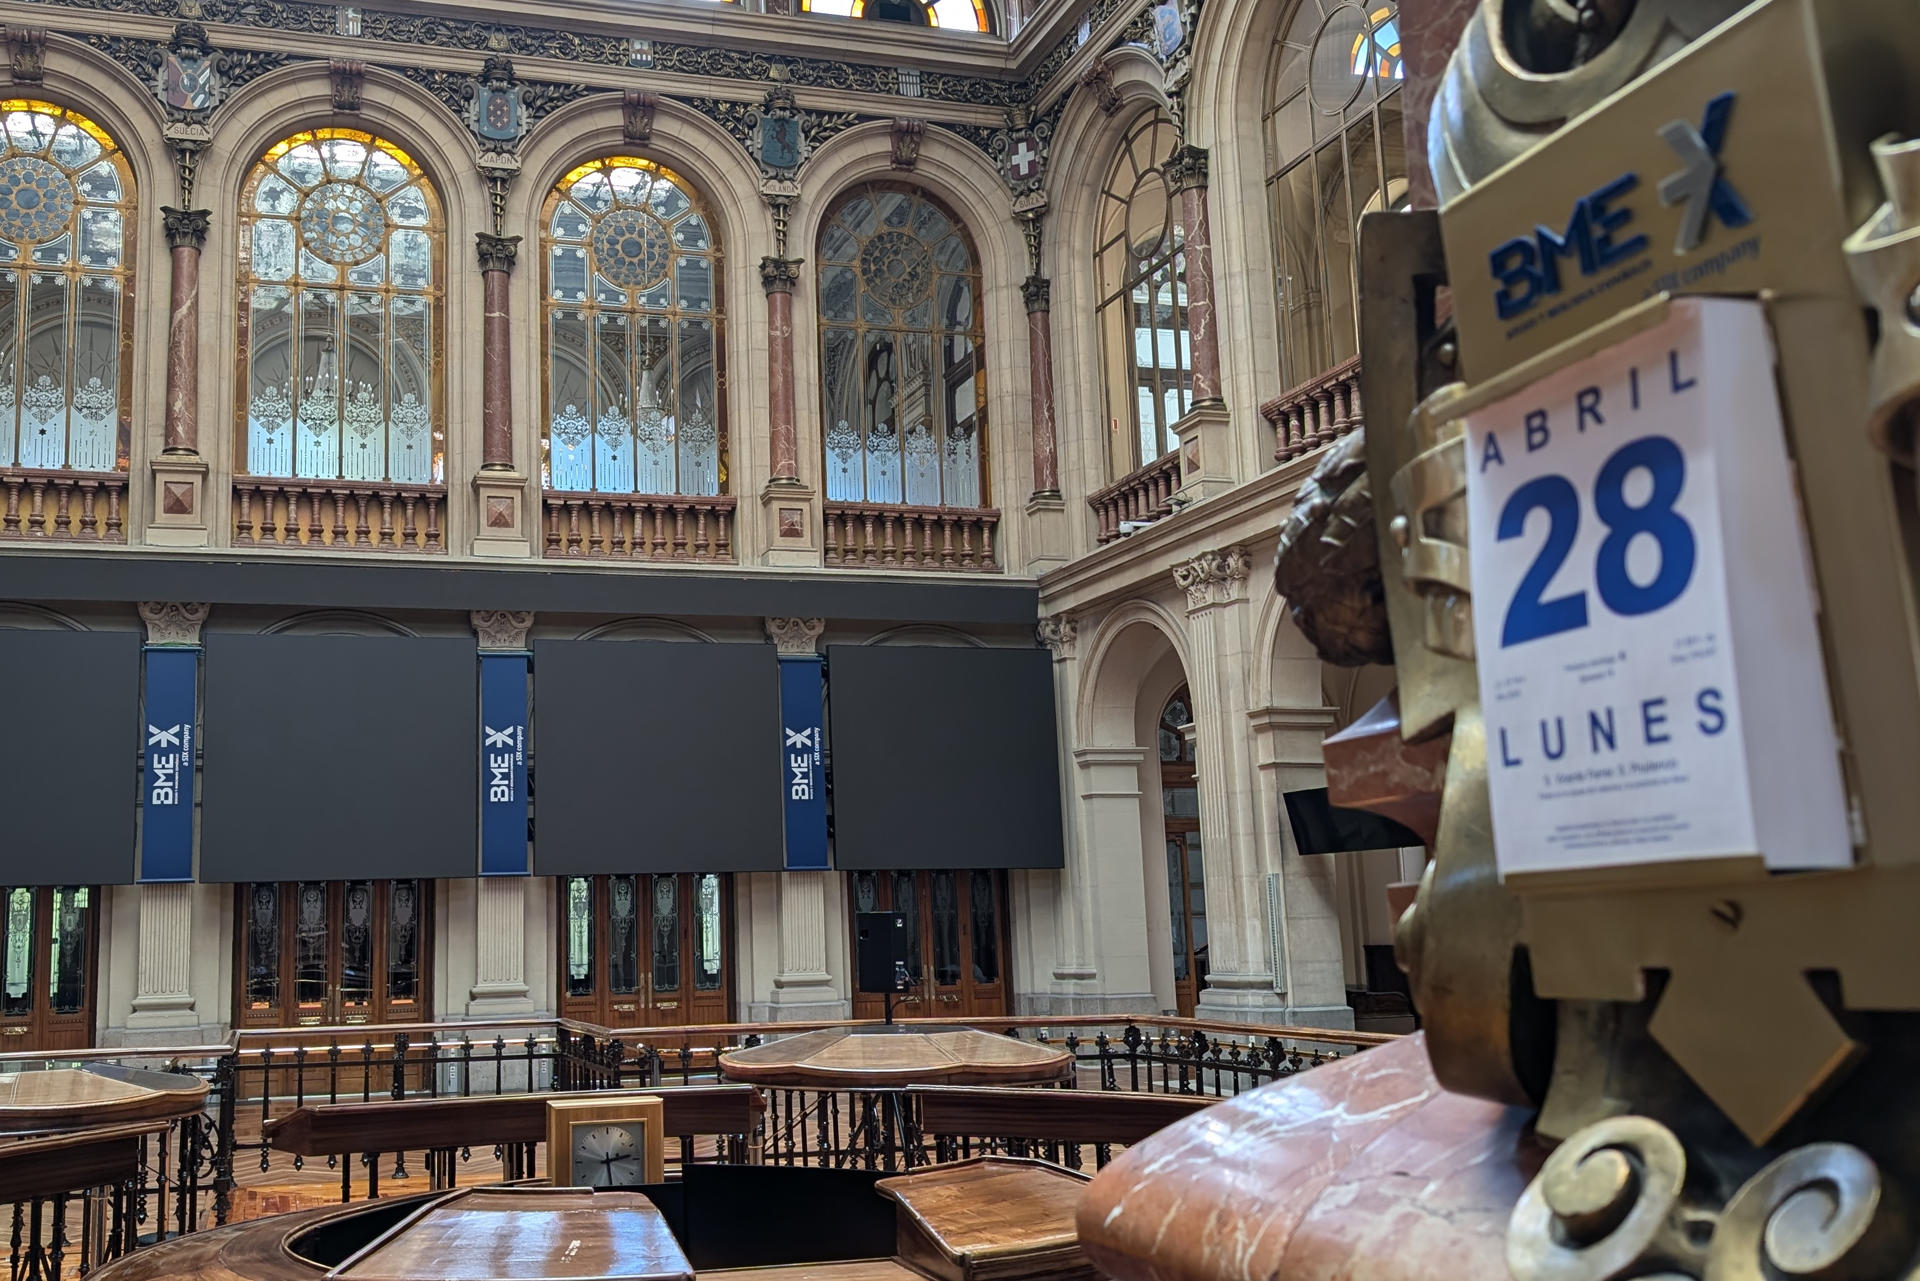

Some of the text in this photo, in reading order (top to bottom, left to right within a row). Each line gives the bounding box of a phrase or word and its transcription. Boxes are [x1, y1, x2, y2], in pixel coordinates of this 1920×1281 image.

[173, 126, 205, 137] SUECIA
[765, 183, 796, 194] HOLANDA
[1489, 172, 1649, 320] BME
[1682, 236, 1762, 287] company
[1479, 349, 1698, 474] ABRIL
[1496, 433, 1697, 649] 28
[183, 723, 192, 751] company
[516, 725, 524, 751] company
[1499, 687, 1727, 768] LUNES
[152, 753, 174, 805] BME
[490, 753, 509, 802] BME
[790, 753, 809, 800] BME
